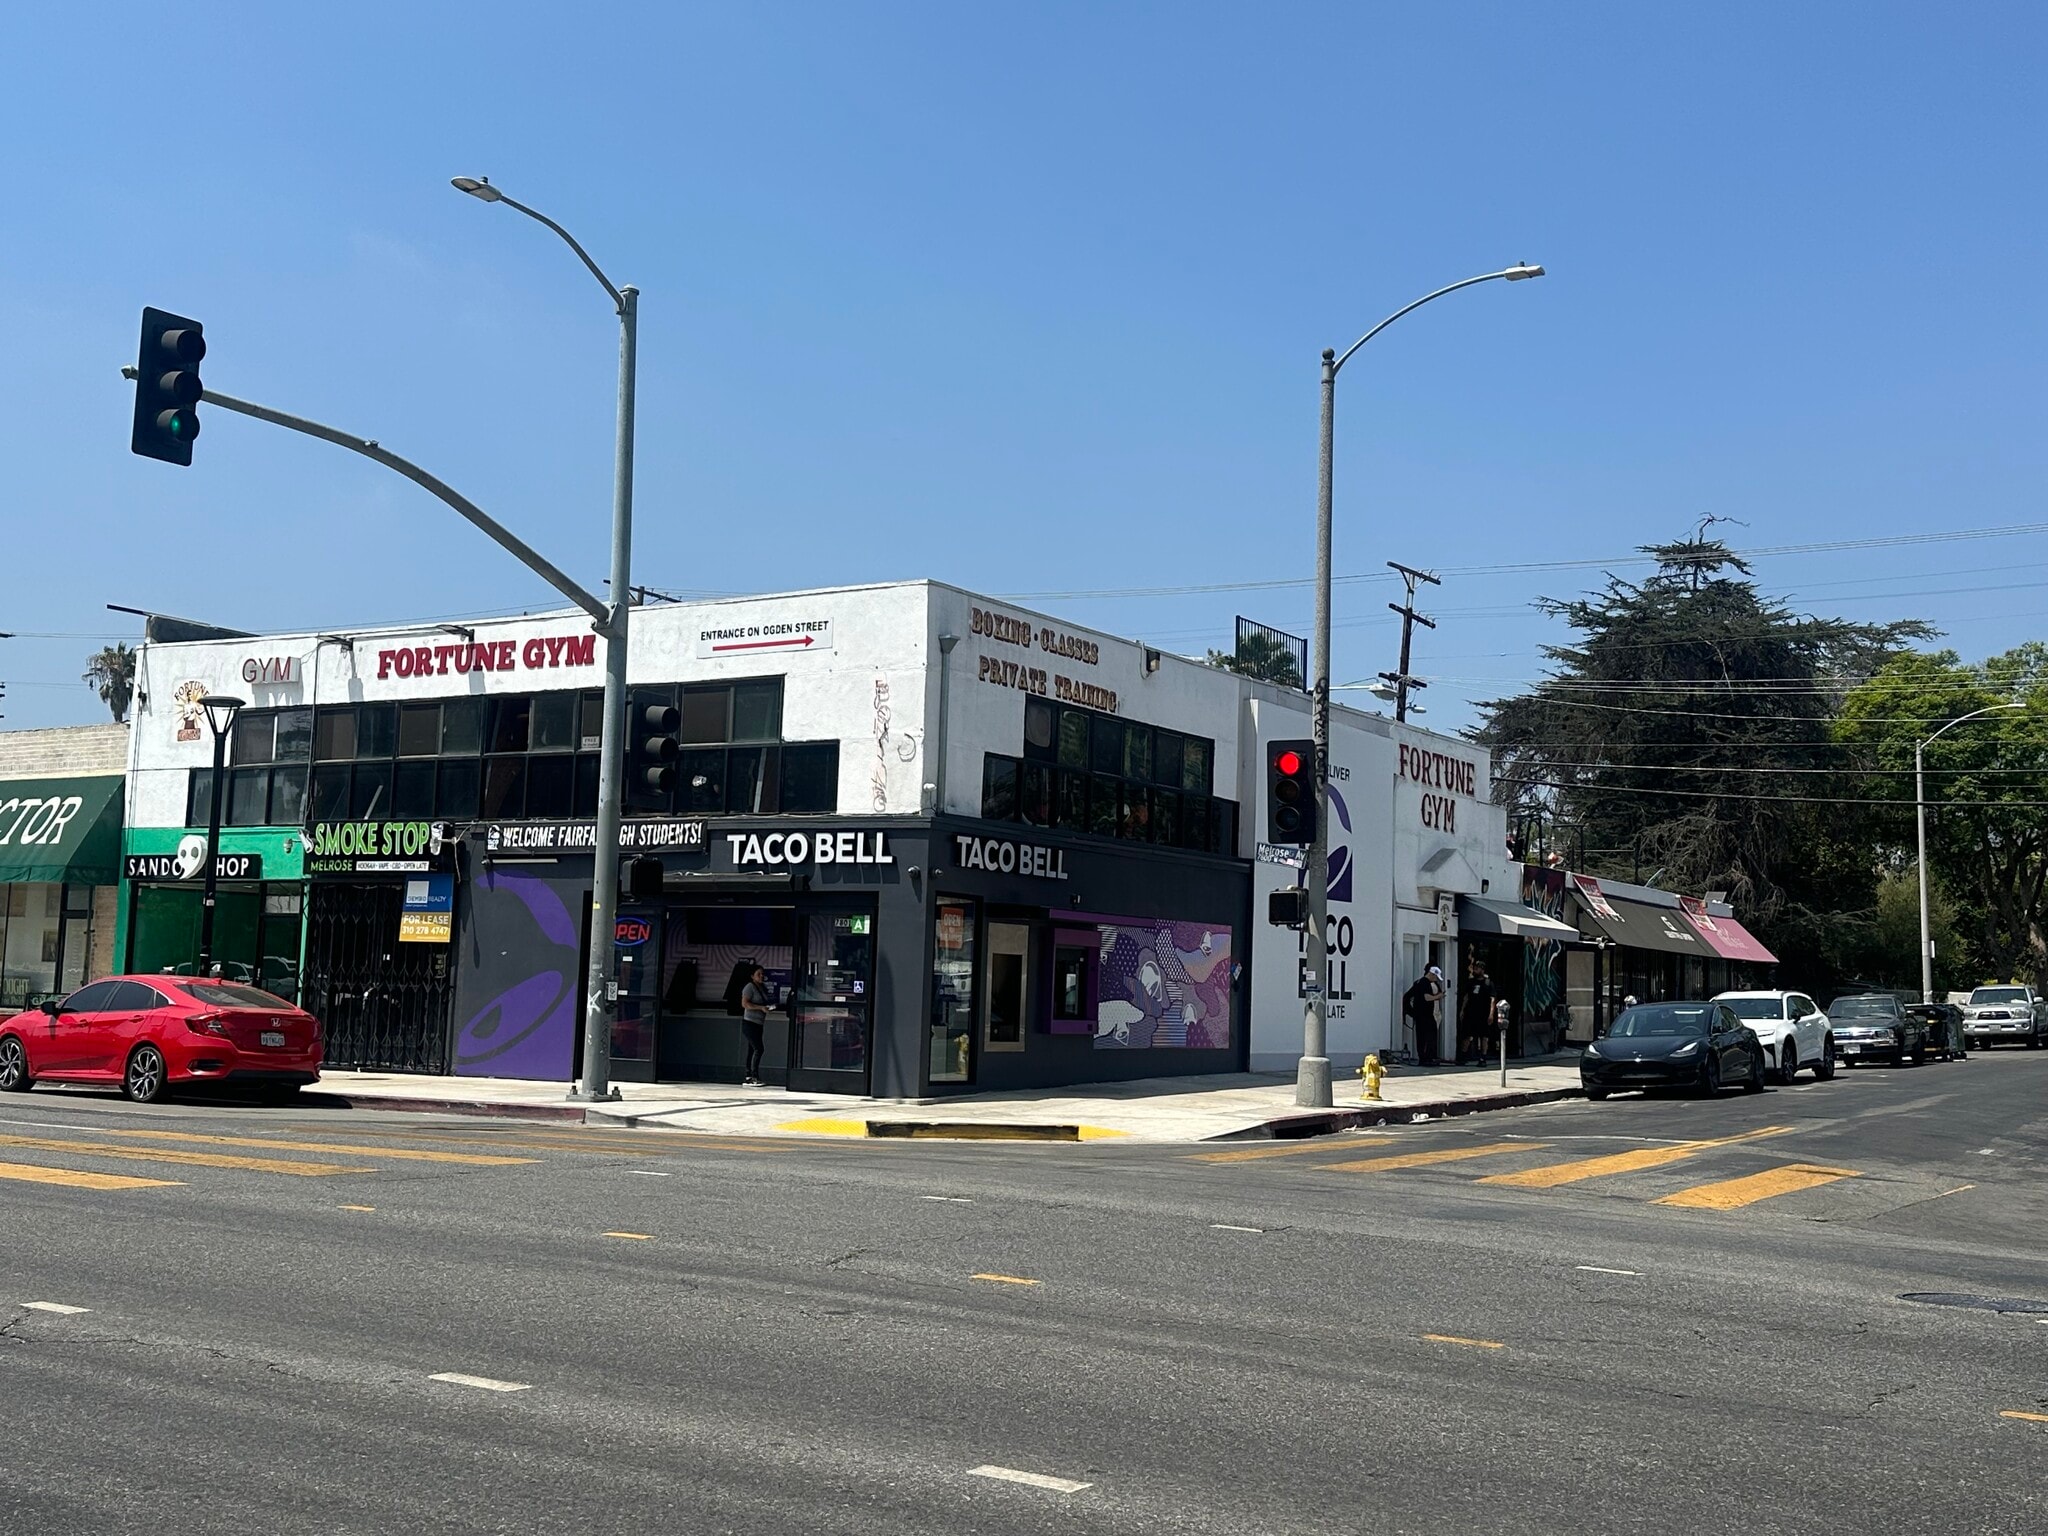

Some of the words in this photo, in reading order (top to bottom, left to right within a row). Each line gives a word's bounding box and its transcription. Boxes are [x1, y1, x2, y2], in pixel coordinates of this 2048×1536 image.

[701, 628, 745, 641] ENTRANCE
[747, 627, 759, 637] ON
[763, 624, 793, 635] OGDEN
[795, 621, 829, 632] STREET
[972, 607, 1031, 648] BOXING
[1040, 628, 1099, 665] CLASSES
[377, 640, 516, 680] FORTUNE
[522, 634, 596, 669] GYM
[242, 656, 291, 683] GYM
[978, 655, 1047, 695] PRIVATE
[1054, 674, 1117, 713] TRAINING
[1327, 764, 1351, 781] LIVER
[1399, 743, 1475, 797] FORTUNE
[1421, 793, 1456, 834] GYM
[314, 822, 378, 856] SMOKE
[381, 821, 430, 856] STOP
[502, 825, 557, 847] WELCOME
[557, 824, 597, 847] FAIRFA
[619, 825, 635, 846] GH
[638, 822, 703, 846] STUDENTS!
[727, 833, 808, 864] TACO
[815, 832, 893, 863] BELL
[956, 835, 1015, 873] TACO
[1019, 846, 1068, 880] BELL
[1258, 843, 1289, 858] Melrose
[216, 857, 249, 876] HOP
[310, 860, 352, 871] MELROSE
[403, 862, 415, 870] OPEN
[416, 862, 427, 870] LATE
[403, 914, 420, 925] FOR
[422, 915, 449, 925] LEASE
[853, 918, 863, 930] A
[402, 926, 414, 935] 310
[431, 926, 449, 936] 4747
[614, 924, 650, 941] PEN
[1327, 1005, 1345, 1018] LATE
